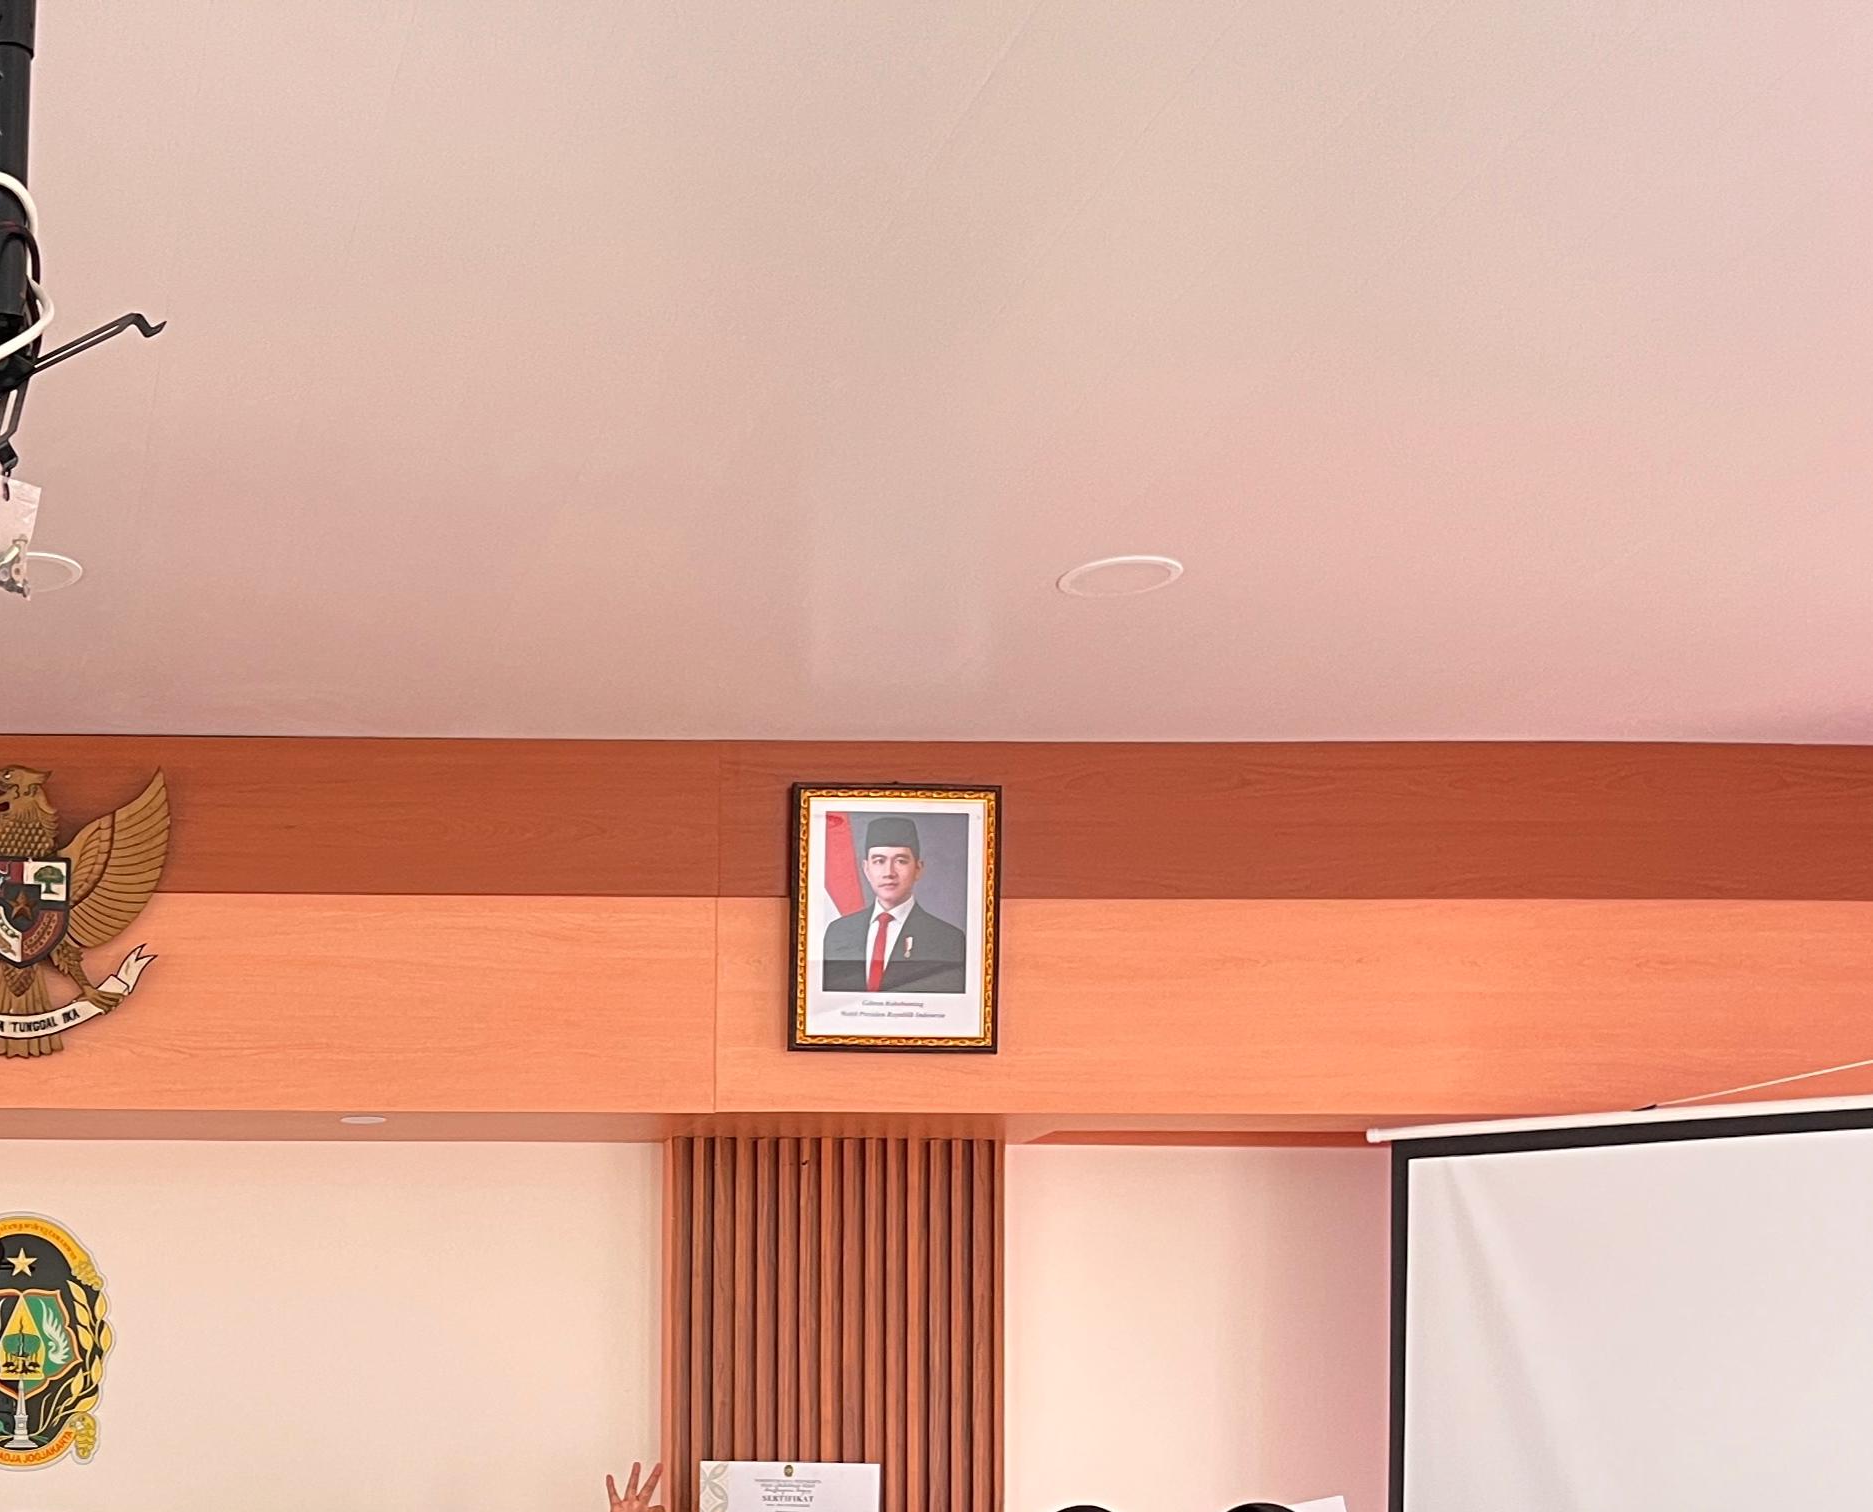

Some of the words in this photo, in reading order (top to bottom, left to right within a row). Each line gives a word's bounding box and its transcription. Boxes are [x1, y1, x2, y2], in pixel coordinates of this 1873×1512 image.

[10, 1016, 59, 1032] TUNGGAL
[62, 1008, 81, 1024] IKA
[23, 1431, 73, 1463] JOGJAKARTA
